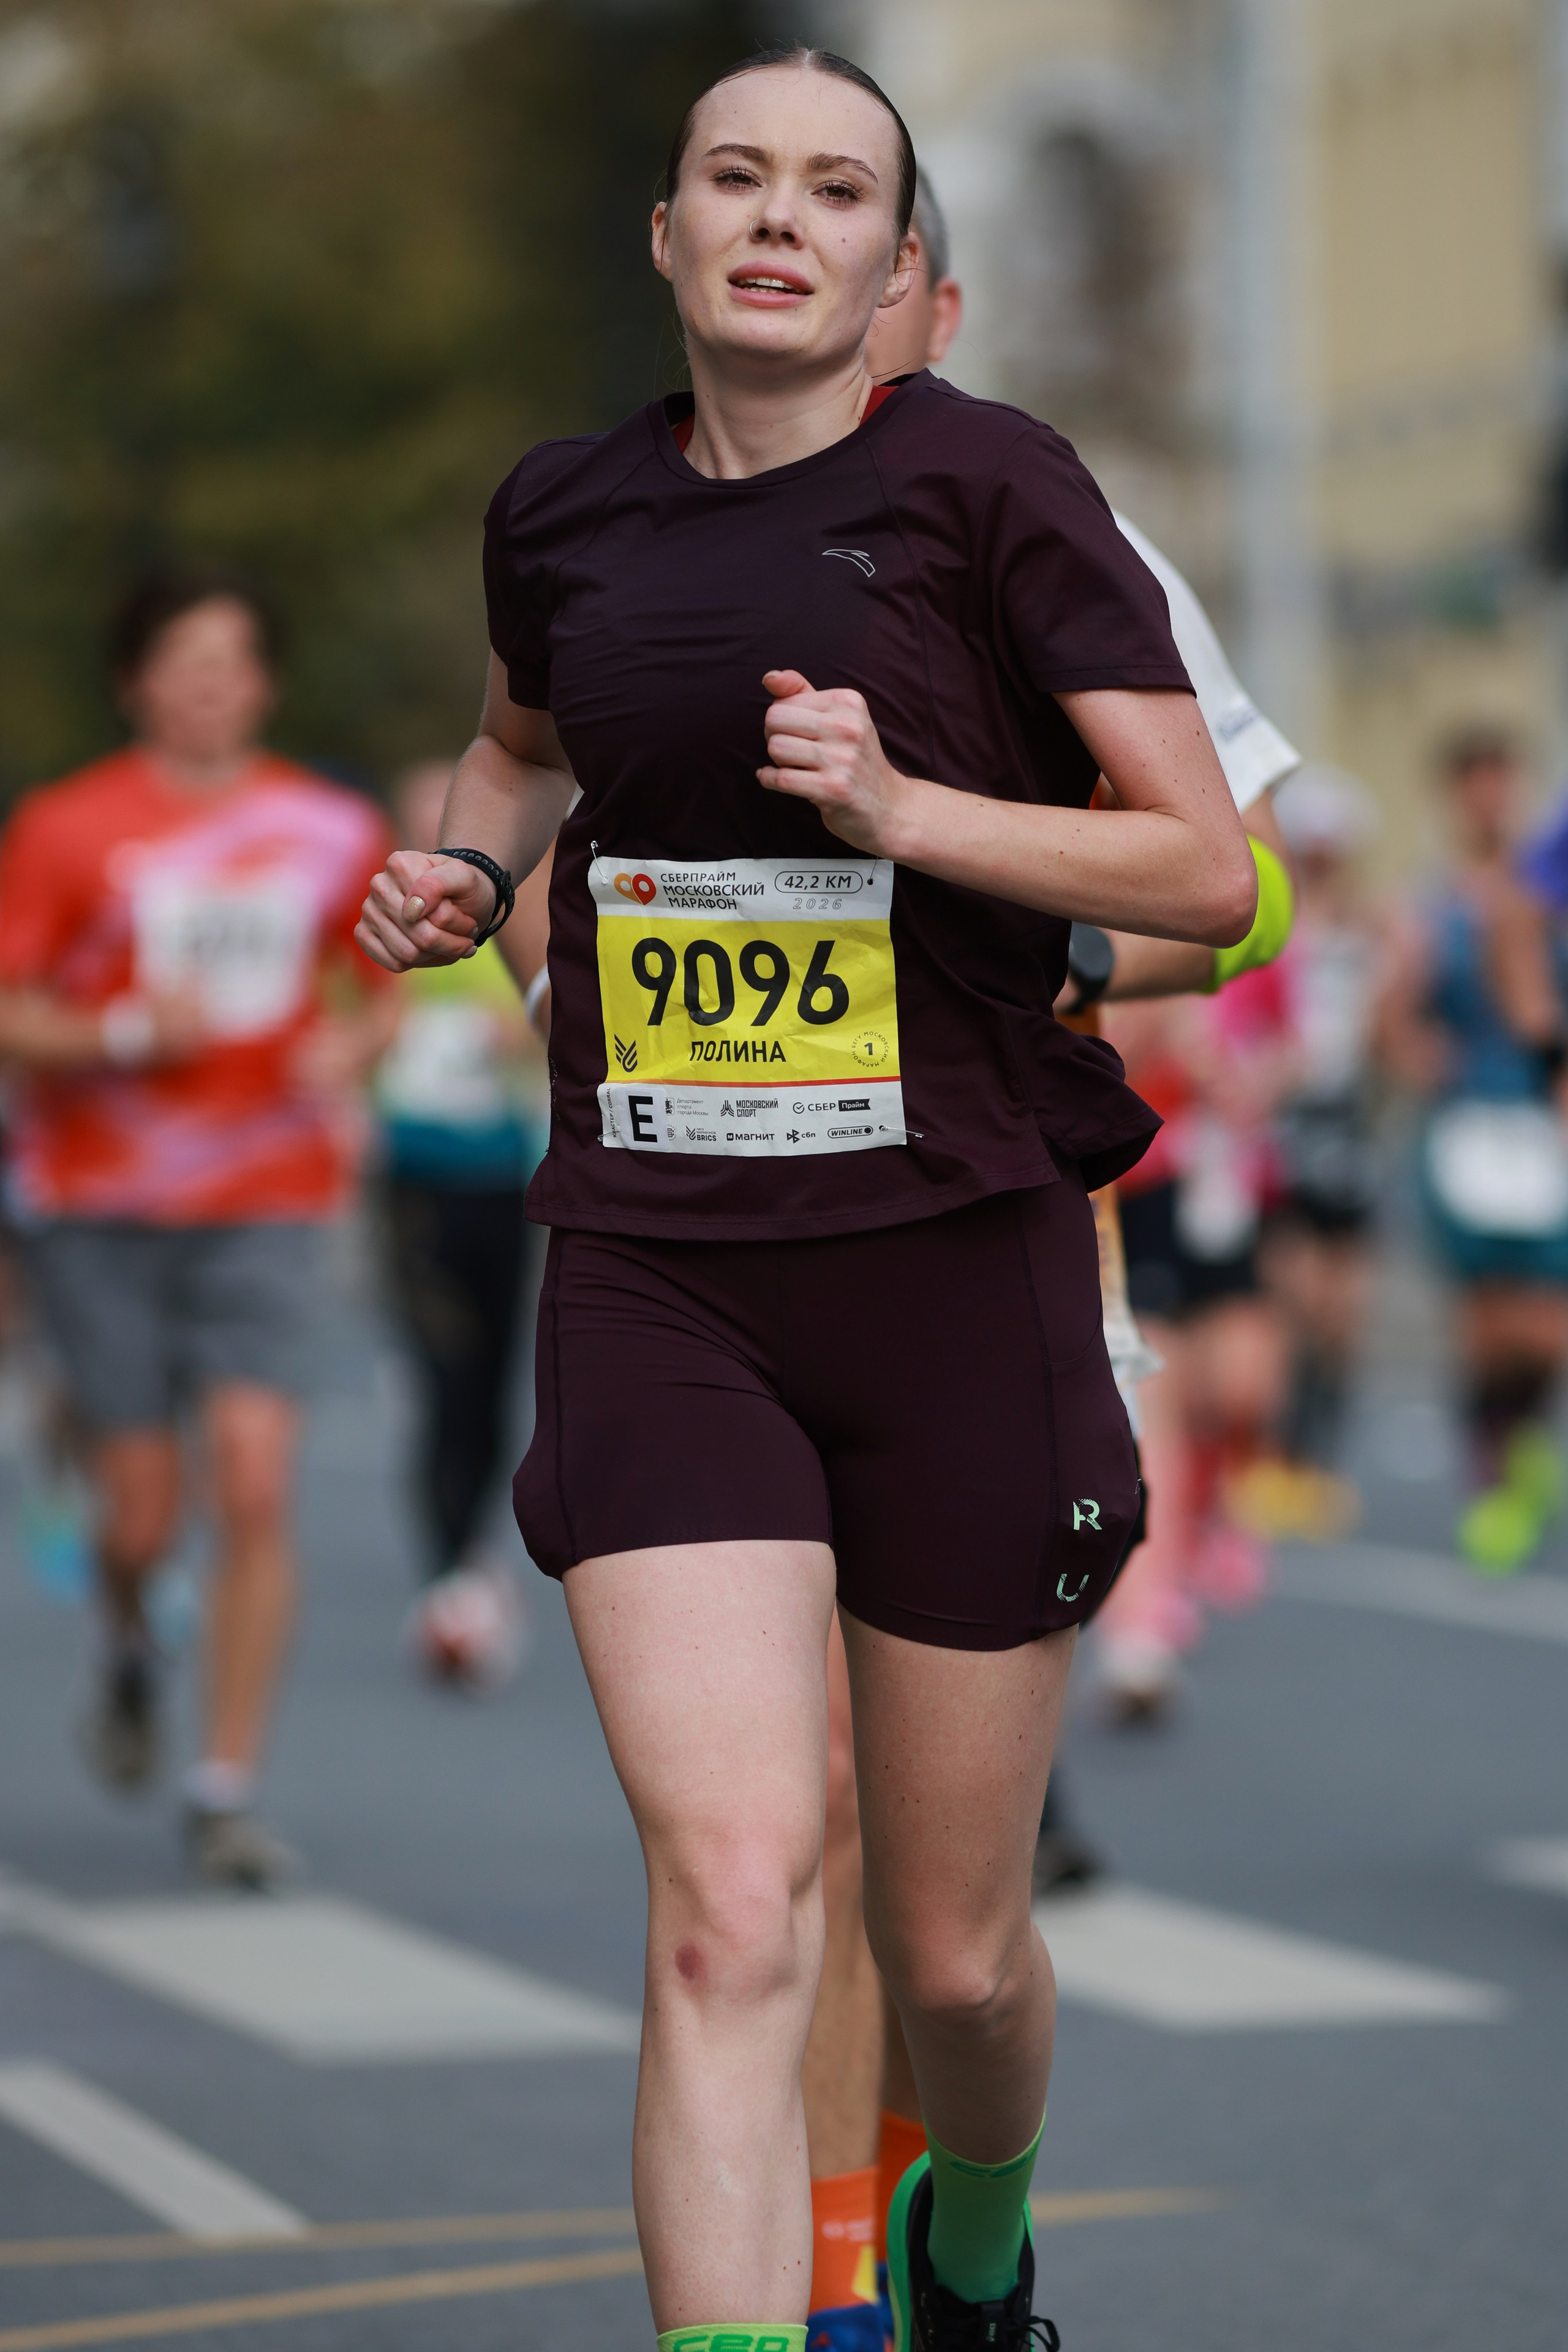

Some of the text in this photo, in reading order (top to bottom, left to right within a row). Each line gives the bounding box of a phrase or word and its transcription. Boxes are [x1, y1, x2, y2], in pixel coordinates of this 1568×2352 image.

[660, 871, 736, 883] СБЕРПРАЙМ
[784, 875, 851, 891] 42,2 КМ
[663, 882, 765, 896] МОСКОВСКИЙ
[668, 897, 737, 910] МАРАФОН
[793, 897, 842, 910] 2026
[631, 937, 850, 1027] 9096
[689, 1040, 786, 1063] ПОЛИНА
[851, 1031, 889, 1068] БЕГУ МОСКОВСКИЙ МАРАФОН
[864, 1042, 873, 1056] 1
[736, 1098, 778, 1109] МОСКОВСКИЙ
[807, 1102, 836, 1112] СБЕР
[628, 1095, 658, 1143] E
[736, 1109, 756, 1118] СПОРТ
[831, 1128, 863, 1137] WINLINE
